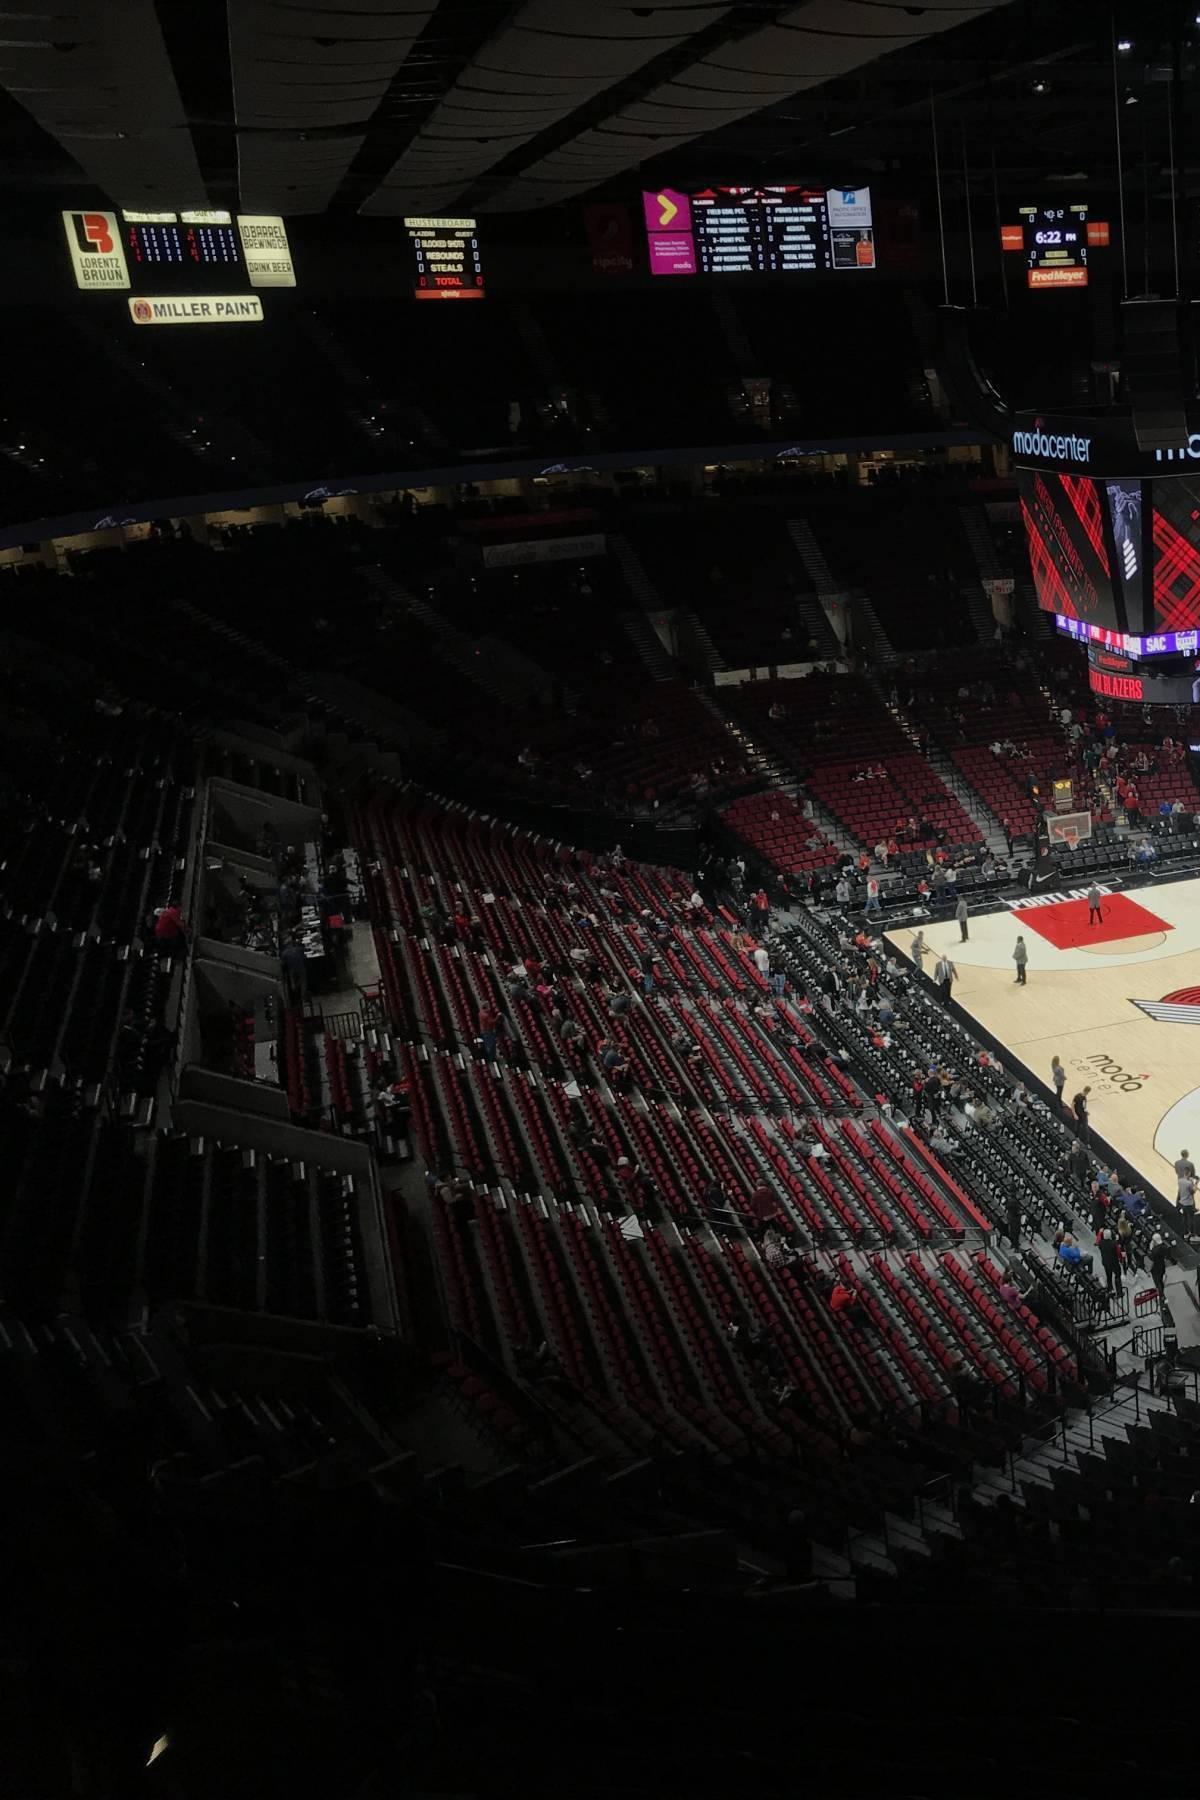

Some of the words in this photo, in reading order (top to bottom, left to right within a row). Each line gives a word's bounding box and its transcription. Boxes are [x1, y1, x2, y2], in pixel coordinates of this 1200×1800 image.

[1029, 214, 1034, 222] 0
[1080, 212, 1085, 220] 0
[1035, 231, 1061, 244] 6:22
[426, 252, 464, 260] REBOUNDS
[1031, 251, 1036, 259] 0
[1081, 248, 1086, 257] 0
[80, 258, 120, 268] LORENTZ
[248, 262, 271, 272] DRINK
[273, 262, 292, 272] BEER
[430, 264, 463, 272] STEALS
[83, 270, 123, 280] BRUUN
[434, 277, 463, 286] TOTAL
[154, 303, 211, 317] MILLER
[216, 302, 258, 316] PAINT
[1013, 427, 1091, 462] modacenter
[1146, 637, 1166, 652] SAC
[1104, 674, 1143, 700] BLAZERS
[1070, 1059, 1120, 1095] center
[1086, 1054, 1142, 1092] moda
